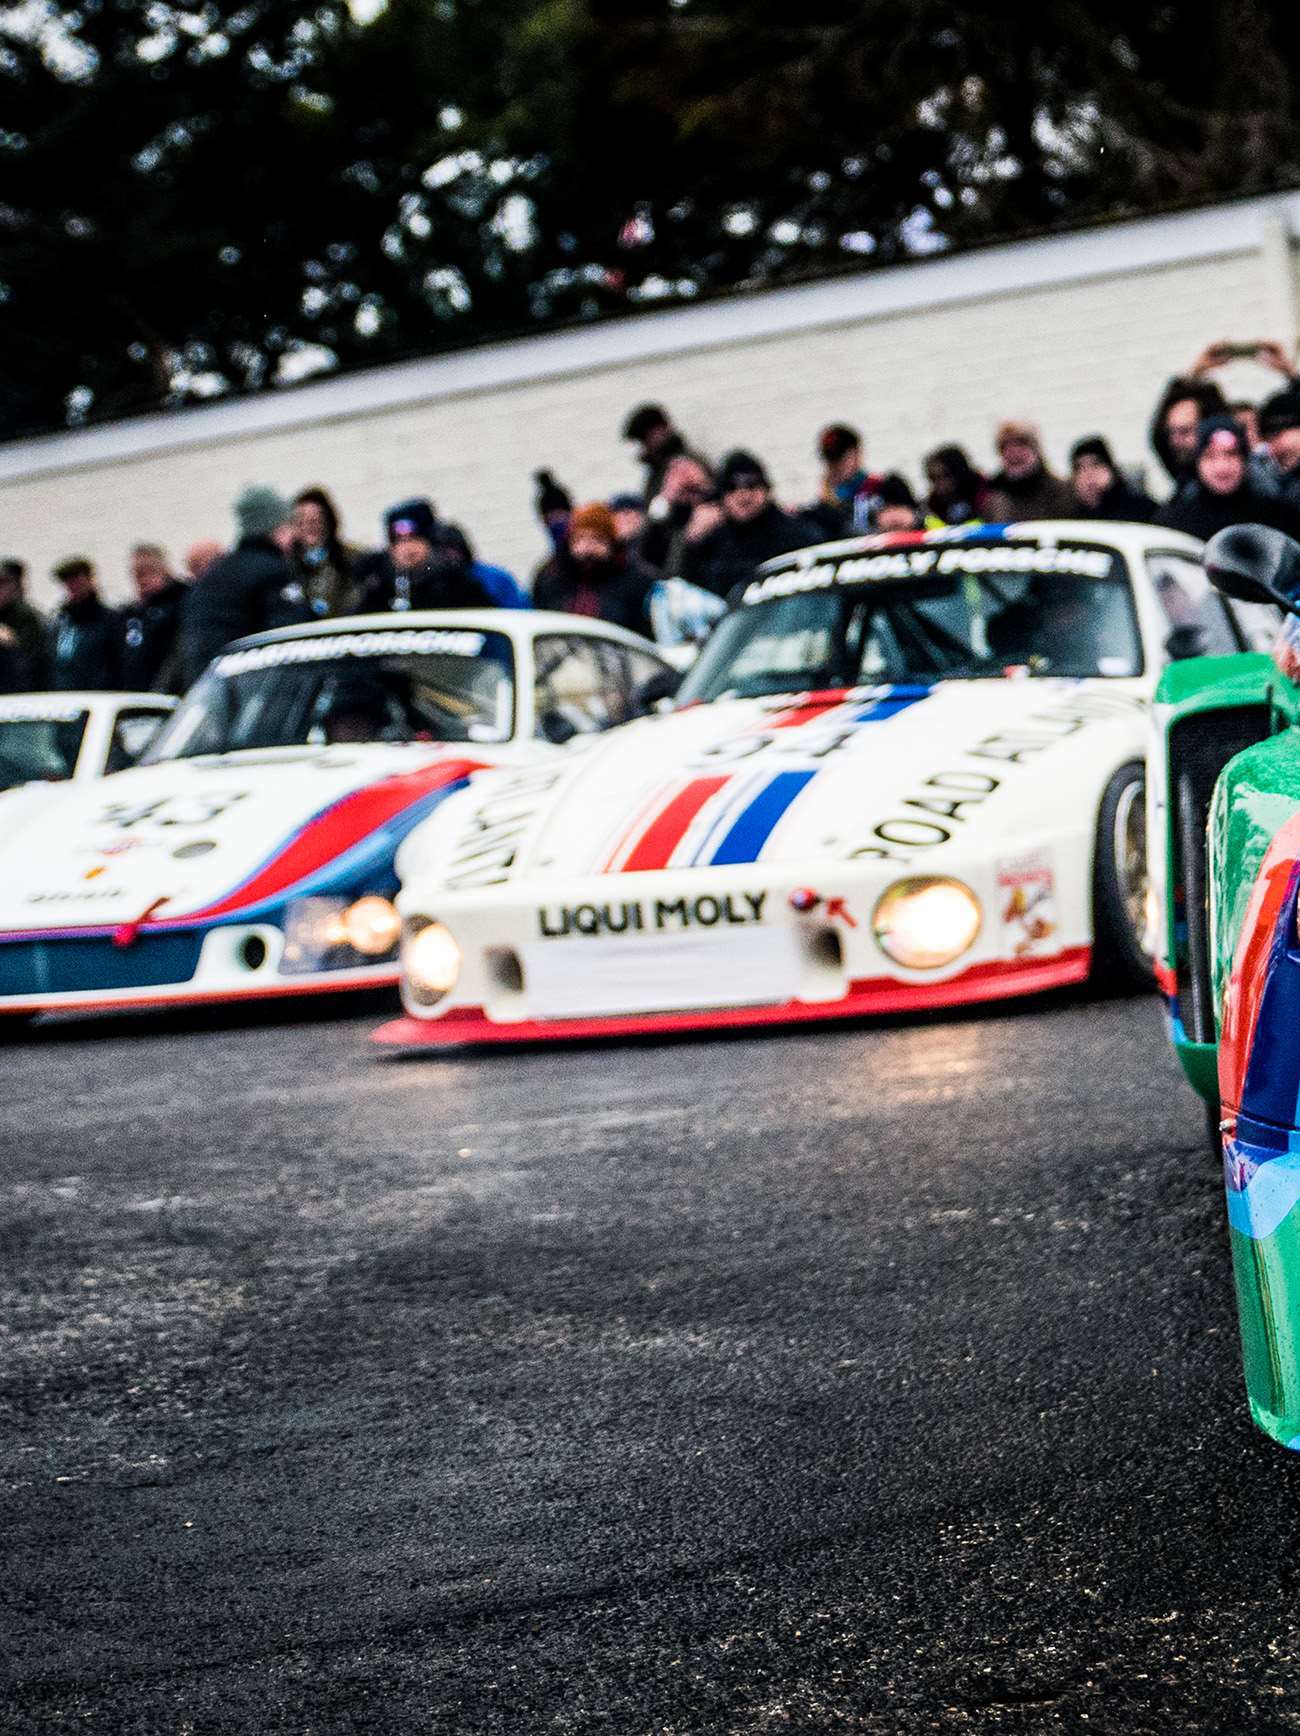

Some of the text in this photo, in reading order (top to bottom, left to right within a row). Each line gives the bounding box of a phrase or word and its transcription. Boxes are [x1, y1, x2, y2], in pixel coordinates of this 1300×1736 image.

[835, 549, 940, 586] MOLY
[936, 547, 1113, 579] PORSCHE
[538, 889, 768, 938] LIQUI MOLY
